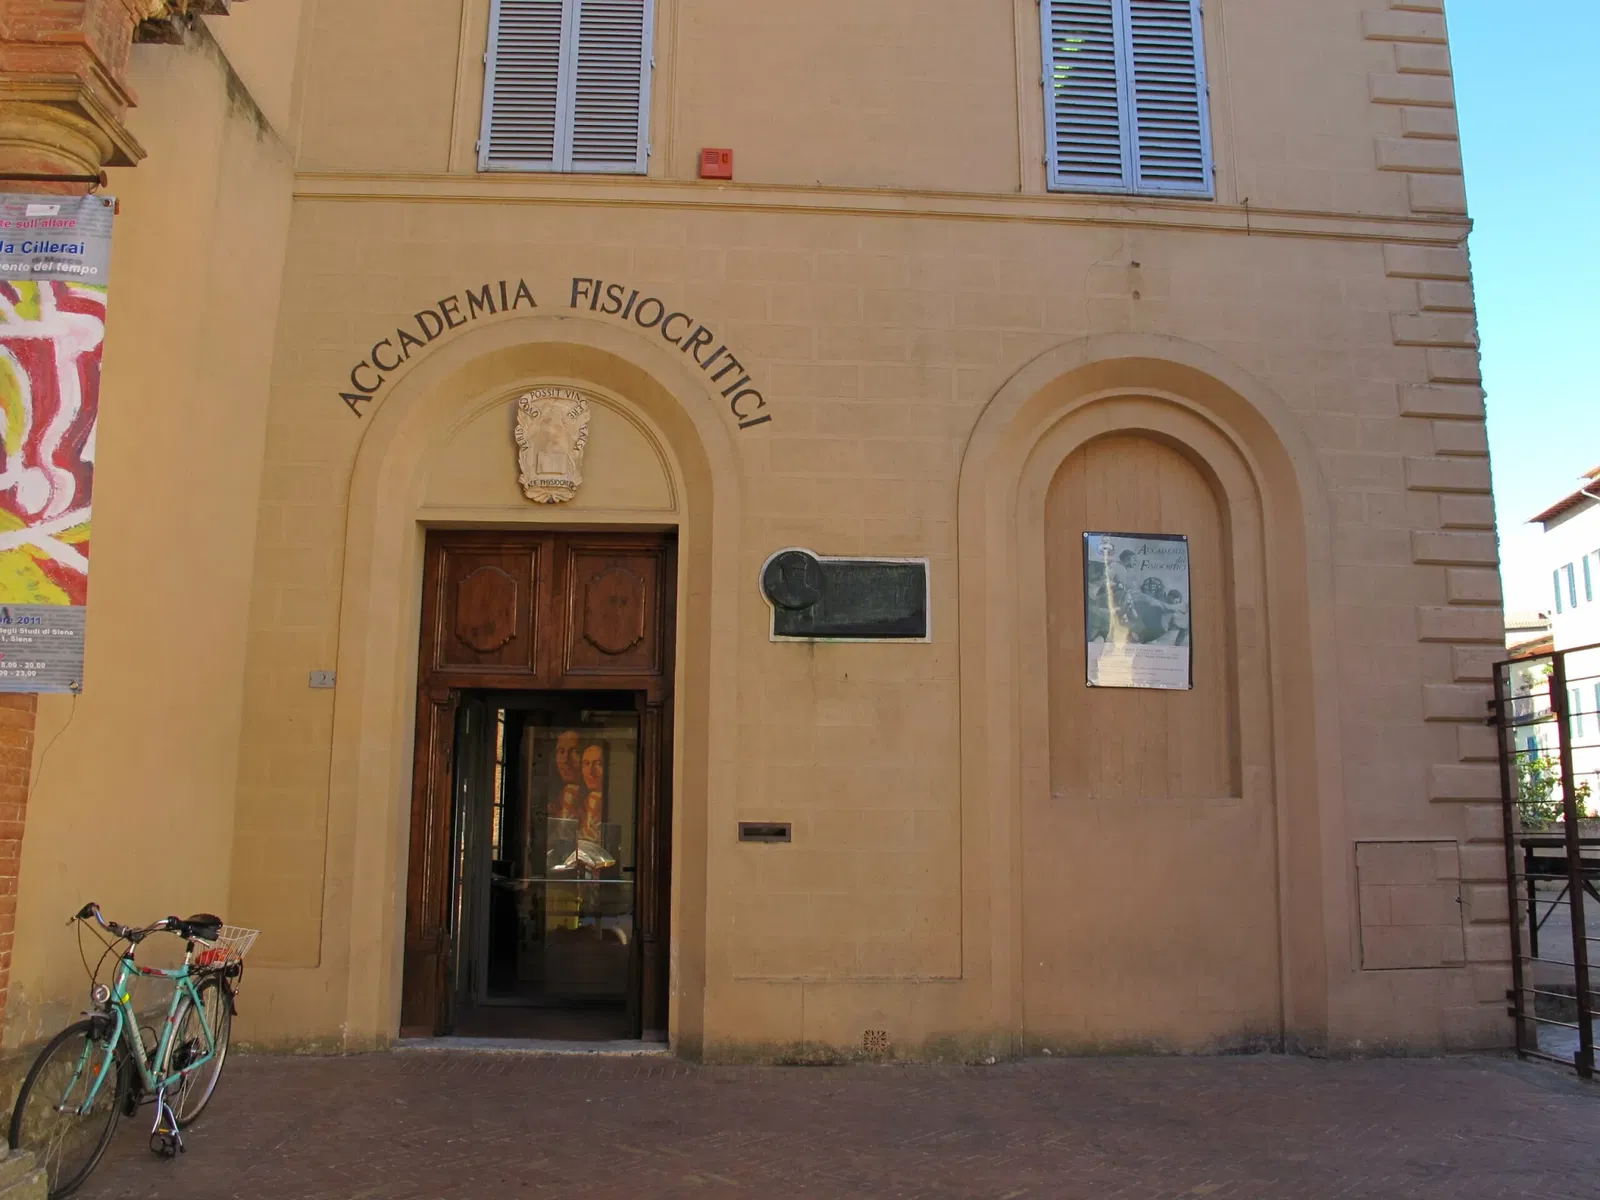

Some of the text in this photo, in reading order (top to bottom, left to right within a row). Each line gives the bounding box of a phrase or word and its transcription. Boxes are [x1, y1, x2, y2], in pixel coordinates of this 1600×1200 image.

[22, 241, 85, 255] Cillerai
[56, 262, 98, 275] tempo
[338, 277, 772, 430] ACCADEMIA FISIOCRITICI
[530, 388, 561, 398] POSSIT
